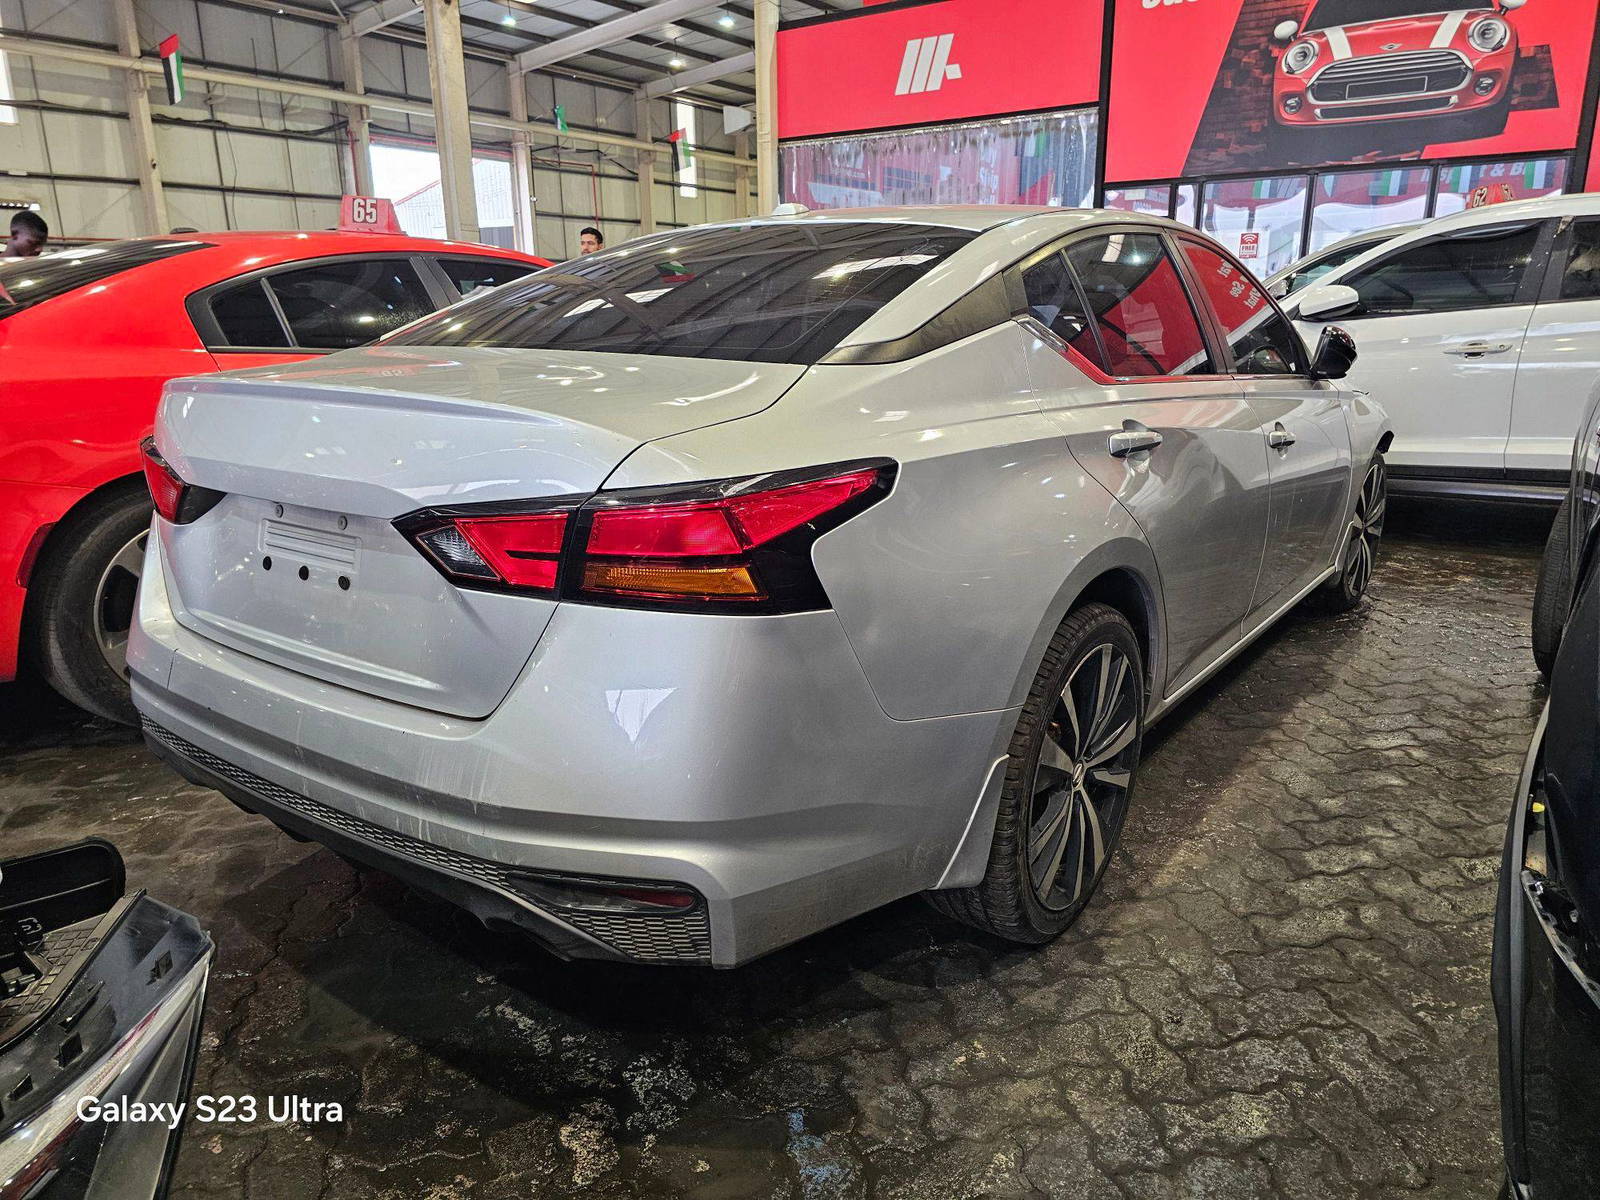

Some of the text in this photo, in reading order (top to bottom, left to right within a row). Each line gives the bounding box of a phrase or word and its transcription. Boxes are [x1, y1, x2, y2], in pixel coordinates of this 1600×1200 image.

[1472, 186, 1488, 208] 62
[353, 198, 377, 224] 65
[1241, 244, 1256, 252] FREE
